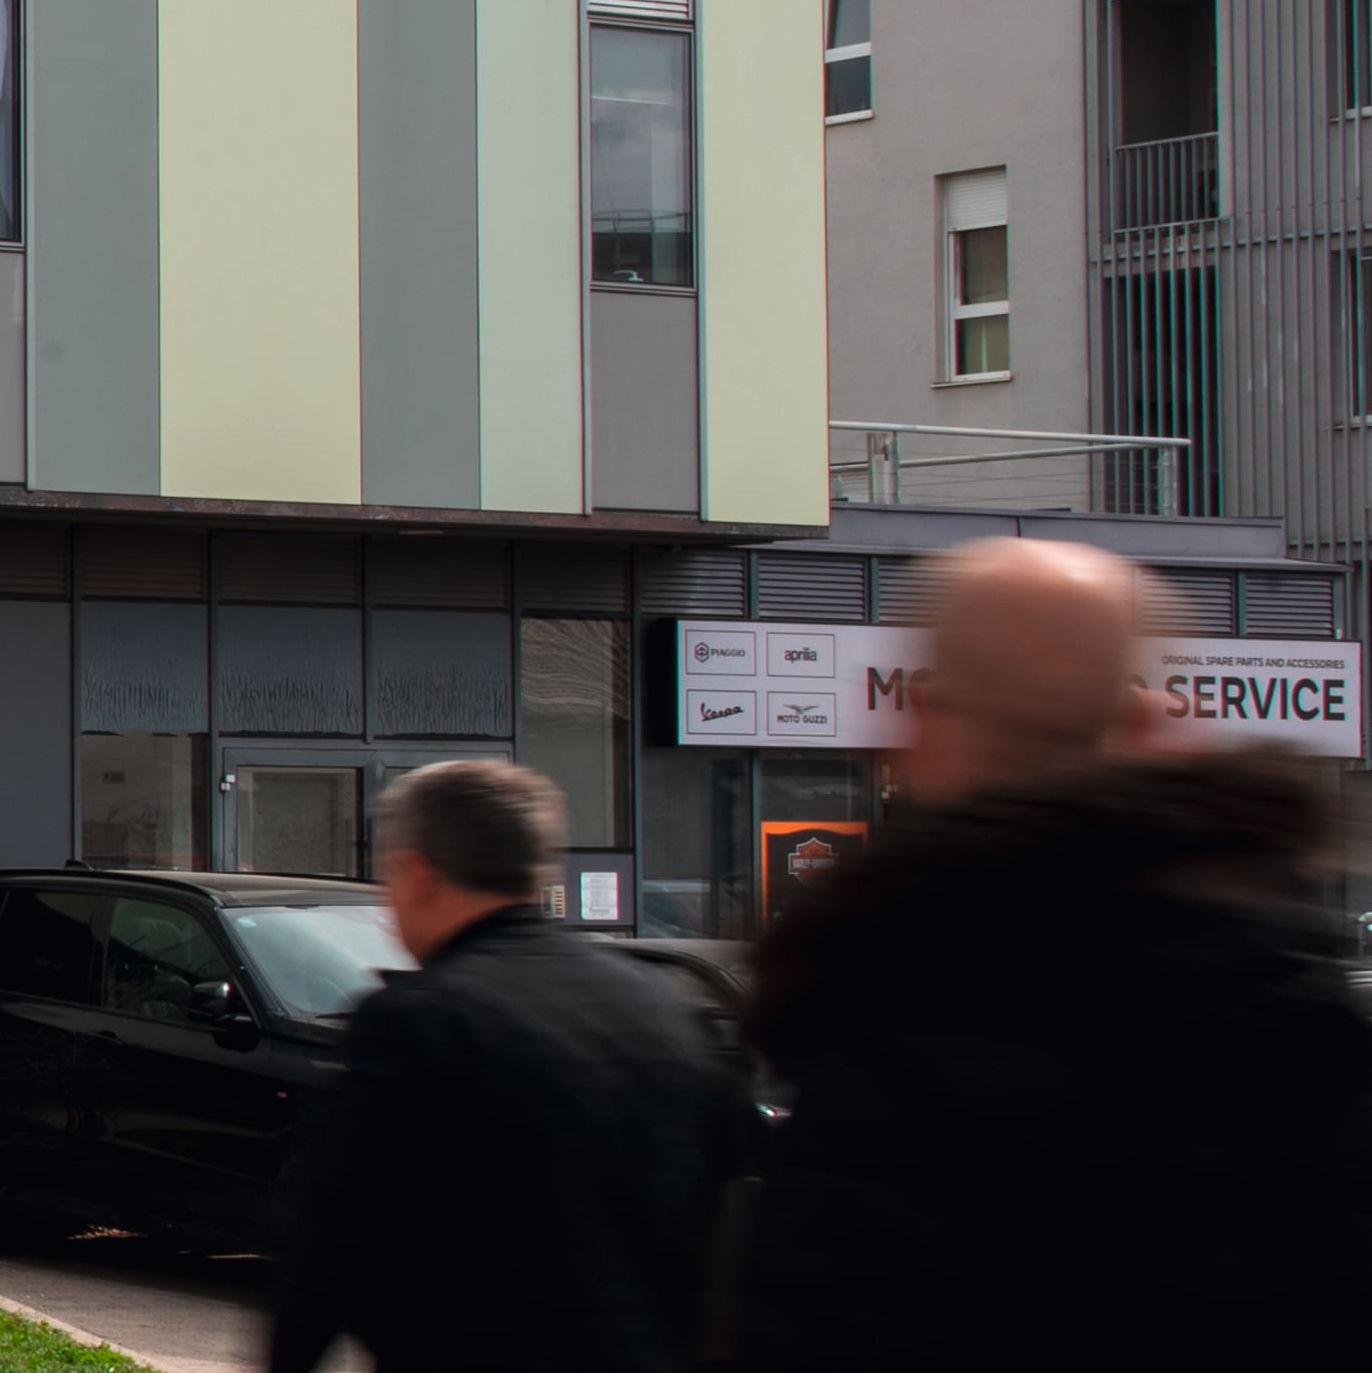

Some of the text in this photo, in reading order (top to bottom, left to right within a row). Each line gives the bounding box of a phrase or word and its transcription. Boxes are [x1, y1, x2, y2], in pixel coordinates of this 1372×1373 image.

[710, 648, 746, 658] PIAGGIO
[784, 646, 818, 664] aprilia
[1161, 655, 1345, 669] ORIGINAL SPARE PARTS AND ACCESSORIES
[1165, 674, 1346, 721] SERVICE
[700, 702, 744, 722] Vespa
[777, 714, 828, 725] MOTO GUZZI
